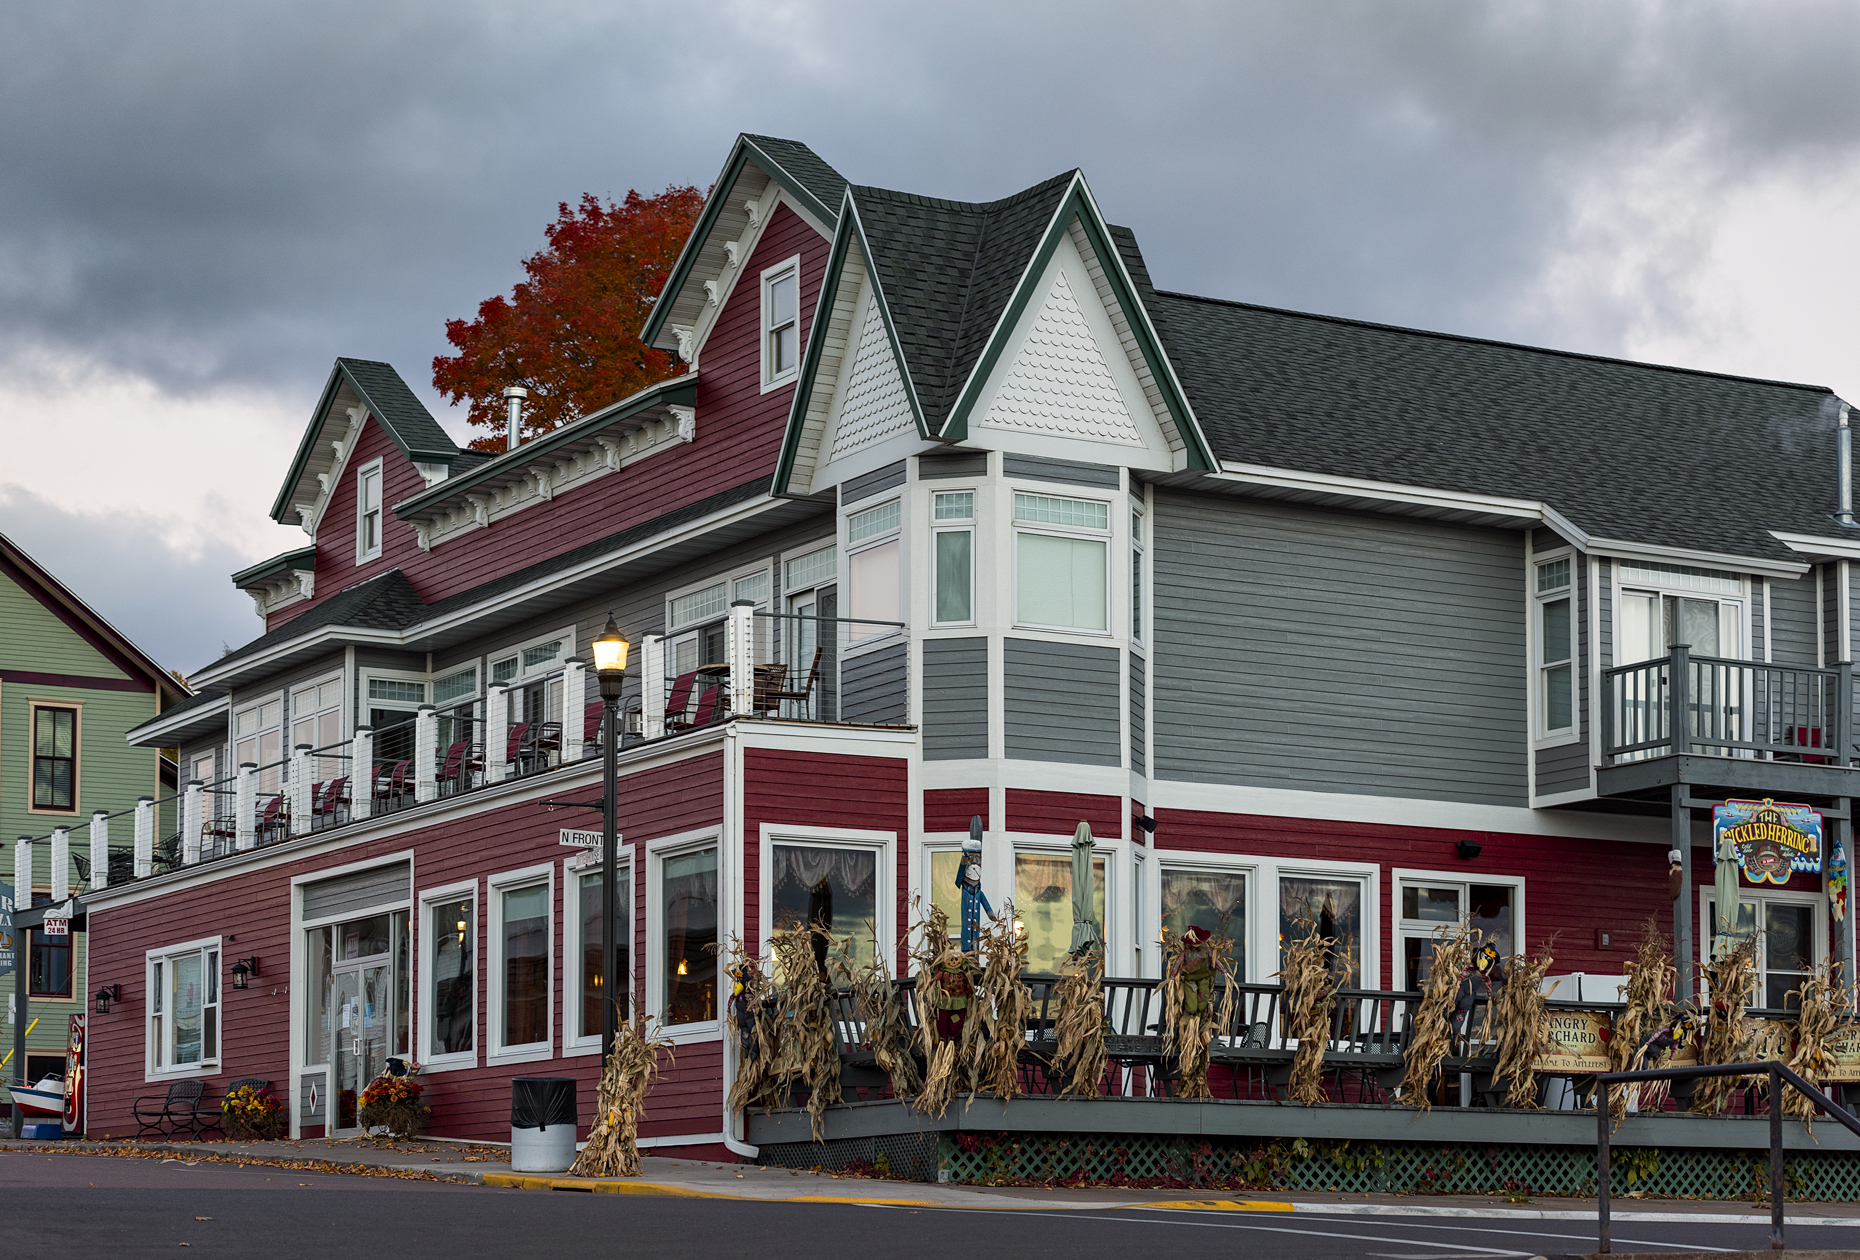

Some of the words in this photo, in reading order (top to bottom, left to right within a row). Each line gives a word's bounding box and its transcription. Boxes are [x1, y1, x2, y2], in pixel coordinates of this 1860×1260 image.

[1759, 811, 1779, 824] THE
[561, 831, 569, 843] N
[572, 832, 604, 845] FRONT
[1767, 822, 1810, 854] HERRING
[46, 919, 67, 927] ATM
